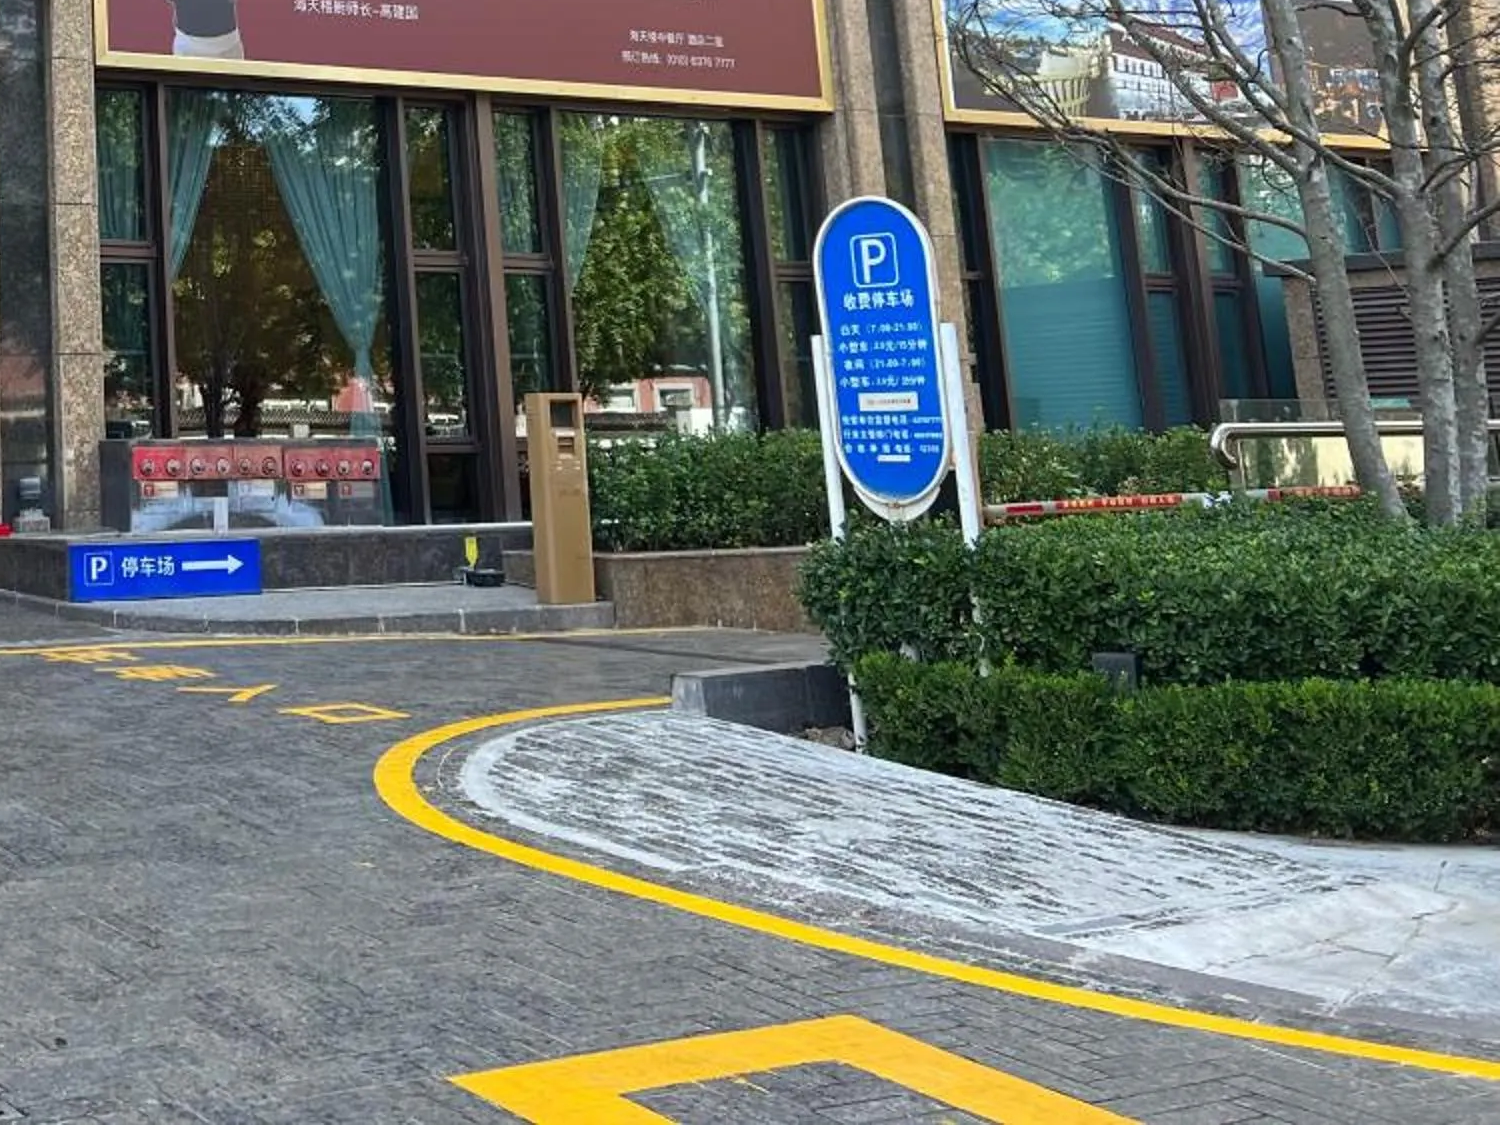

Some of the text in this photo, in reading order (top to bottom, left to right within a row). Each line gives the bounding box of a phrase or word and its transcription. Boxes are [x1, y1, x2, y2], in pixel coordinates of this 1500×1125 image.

[858, 238, 886, 284] P
[843, 289, 915, 311] 收费停车场
[90, 556, 175, 581] P 停车场
